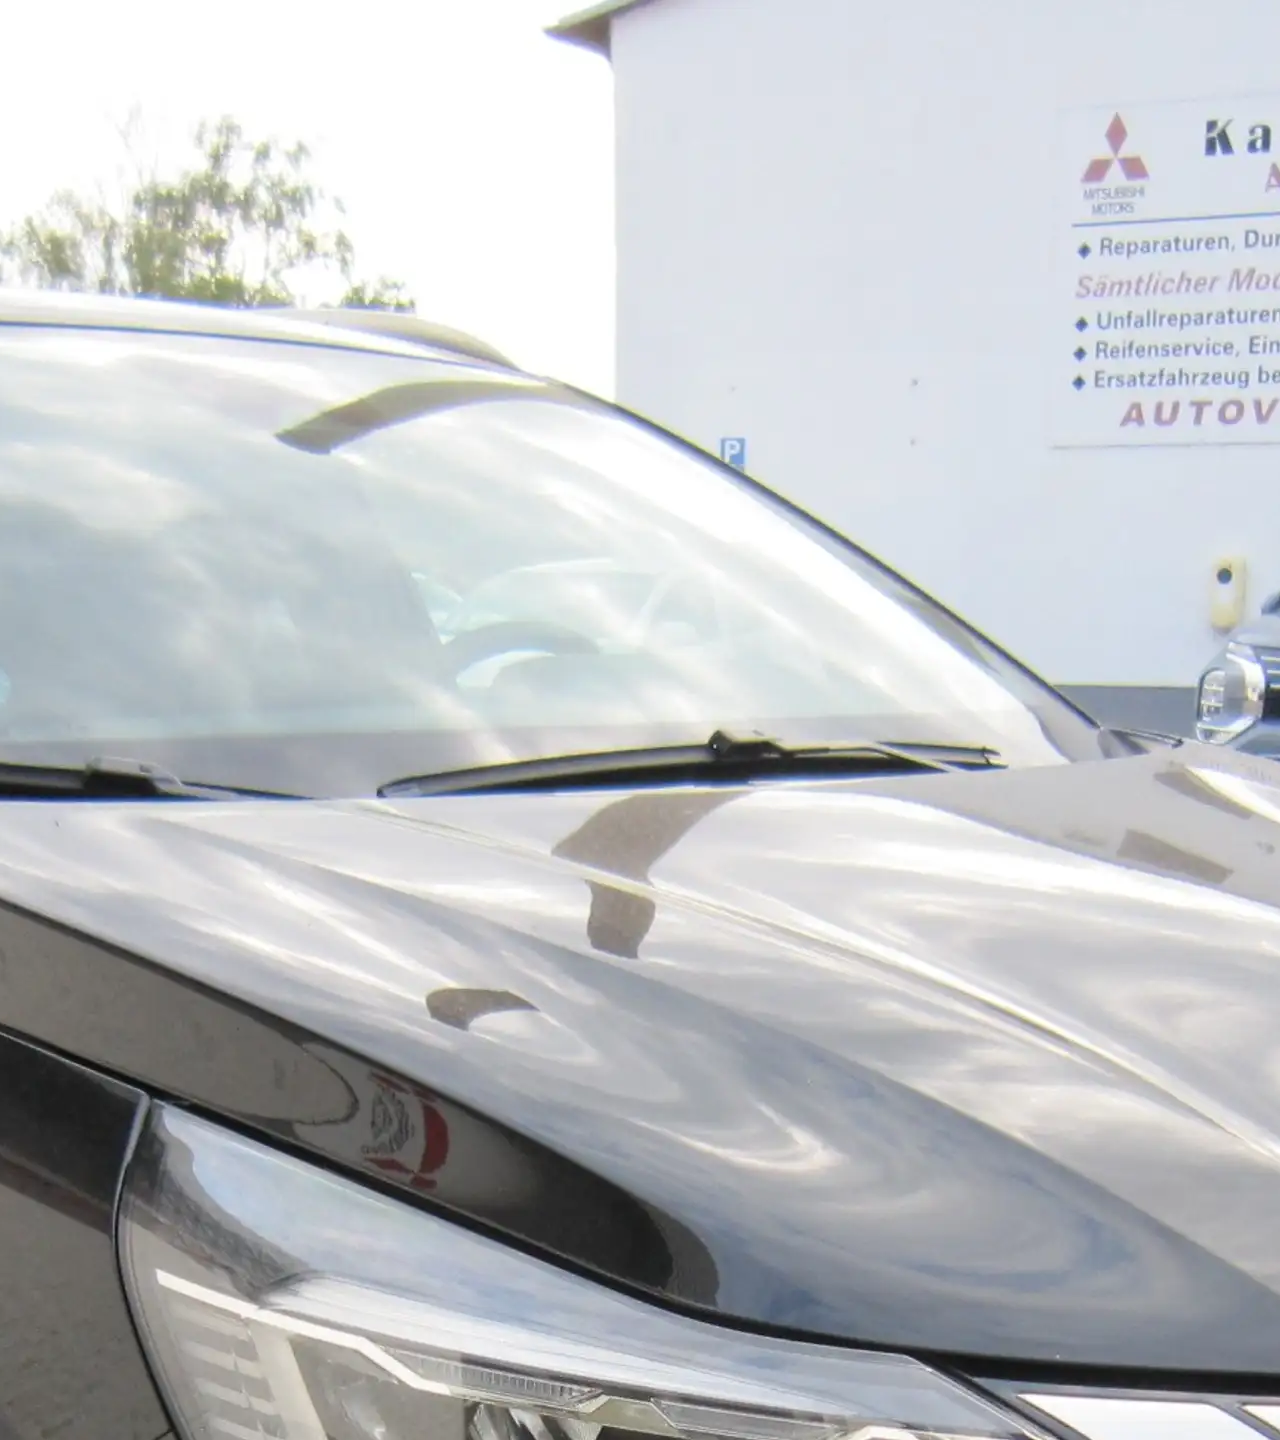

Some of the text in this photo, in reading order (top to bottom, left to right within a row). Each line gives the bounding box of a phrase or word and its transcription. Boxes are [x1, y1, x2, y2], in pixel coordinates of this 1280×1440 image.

[1083, 186, 1145, 201] MITSUBISHI
[1091, 201, 1135, 216] MOTORS
[1099, 232, 1235, 259] Reparaturen,
[1075, 268, 1220, 299] Sämtlicher
[1095, 337, 1240, 360] Reifenservice,
[1093, 367, 1250, 390] Ersatzfahrzeug
